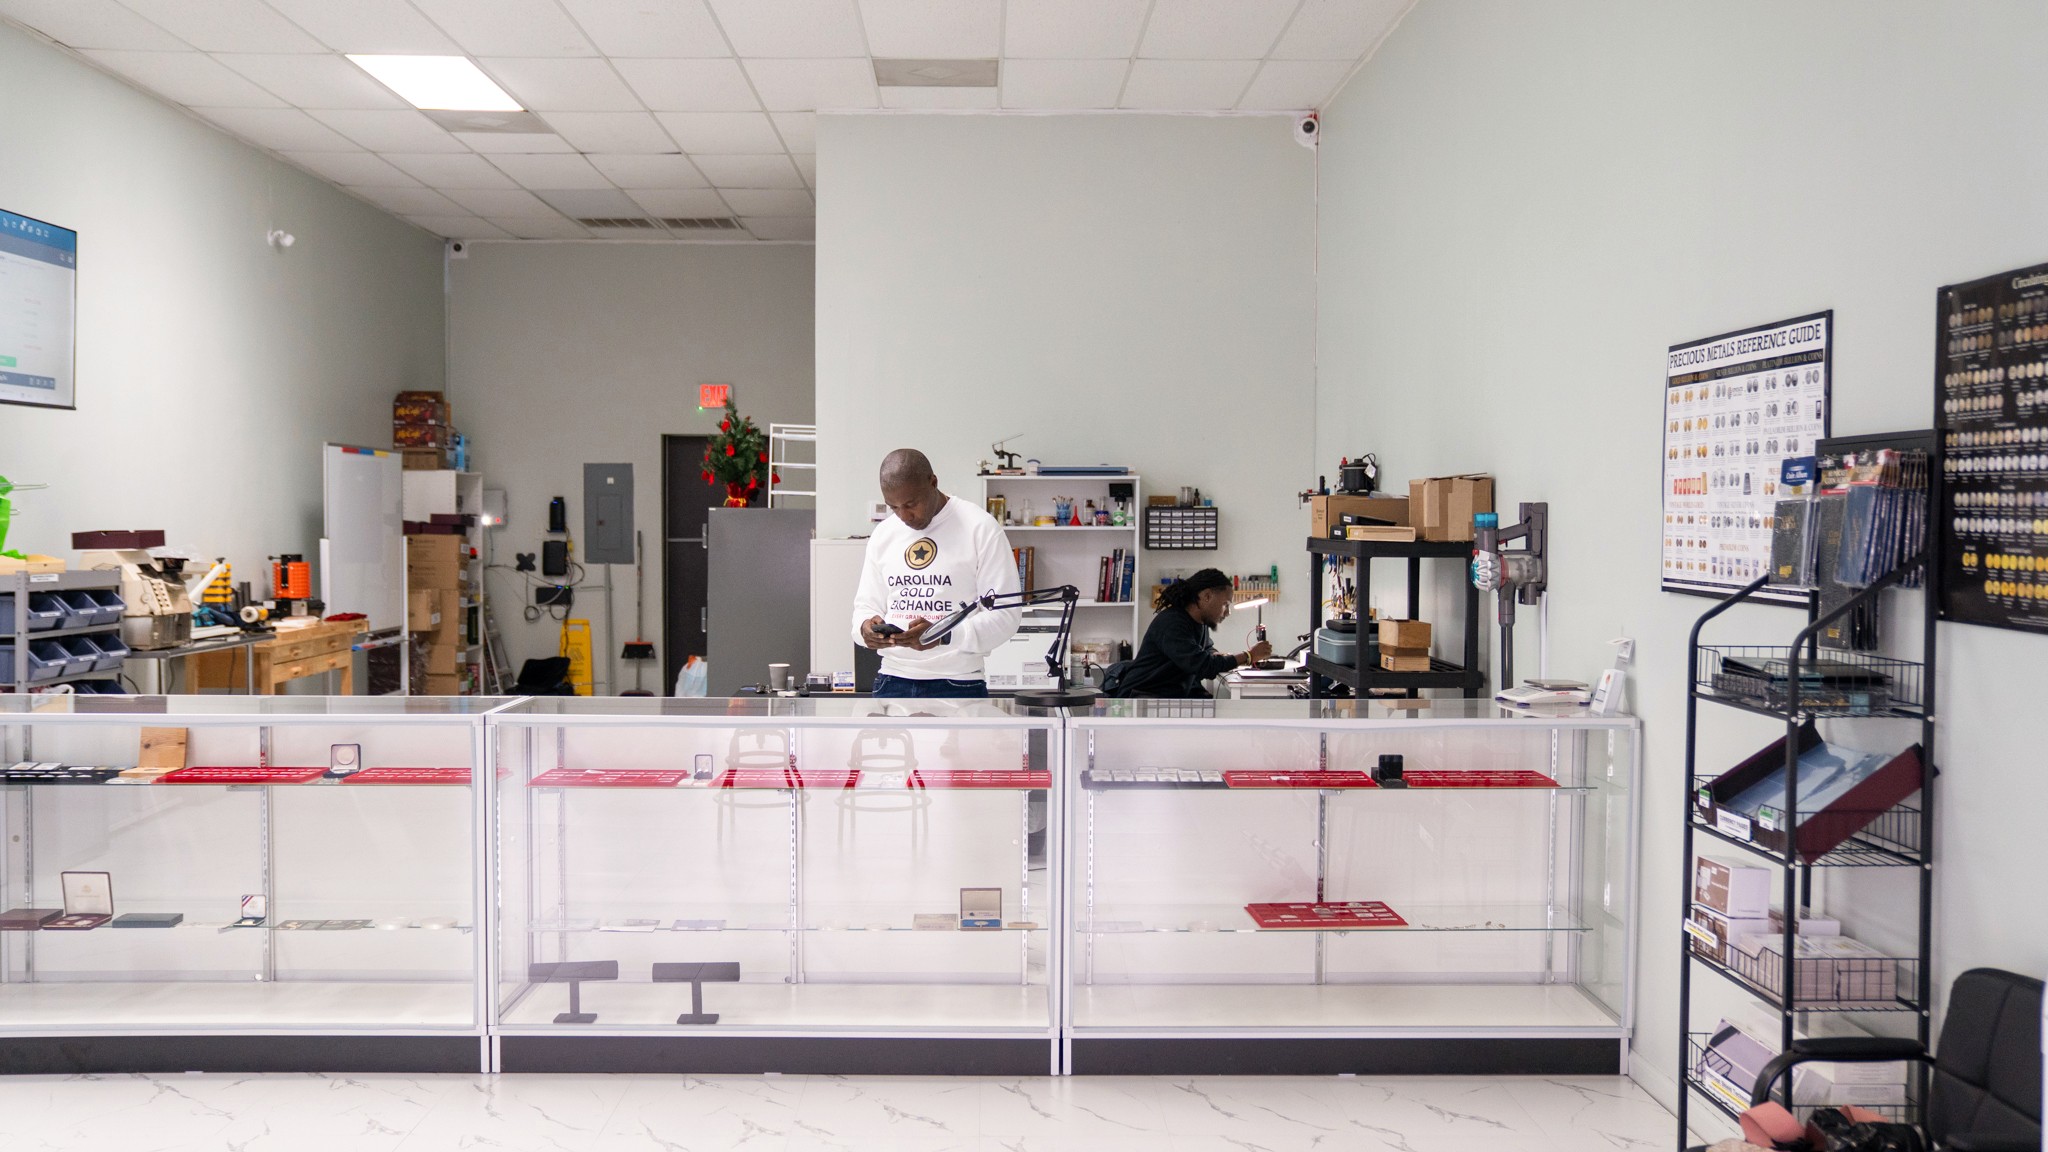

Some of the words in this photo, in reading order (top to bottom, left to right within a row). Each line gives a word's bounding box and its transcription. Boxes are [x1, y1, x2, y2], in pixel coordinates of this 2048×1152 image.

[1669, 348, 1705, 369] PRECIOUS
[1706, 342, 1735, 362] METALS
[1736, 330, 1787, 355] REFERENCE
[1788, 323, 1821, 345] GUIDE
[700, 384, 728, 407] EXIT
[888, 575, 952, 586] CAROLINA
[900, 587, 935, 598] GOLD
[890, 600, 953, 612] EXCHANGE
